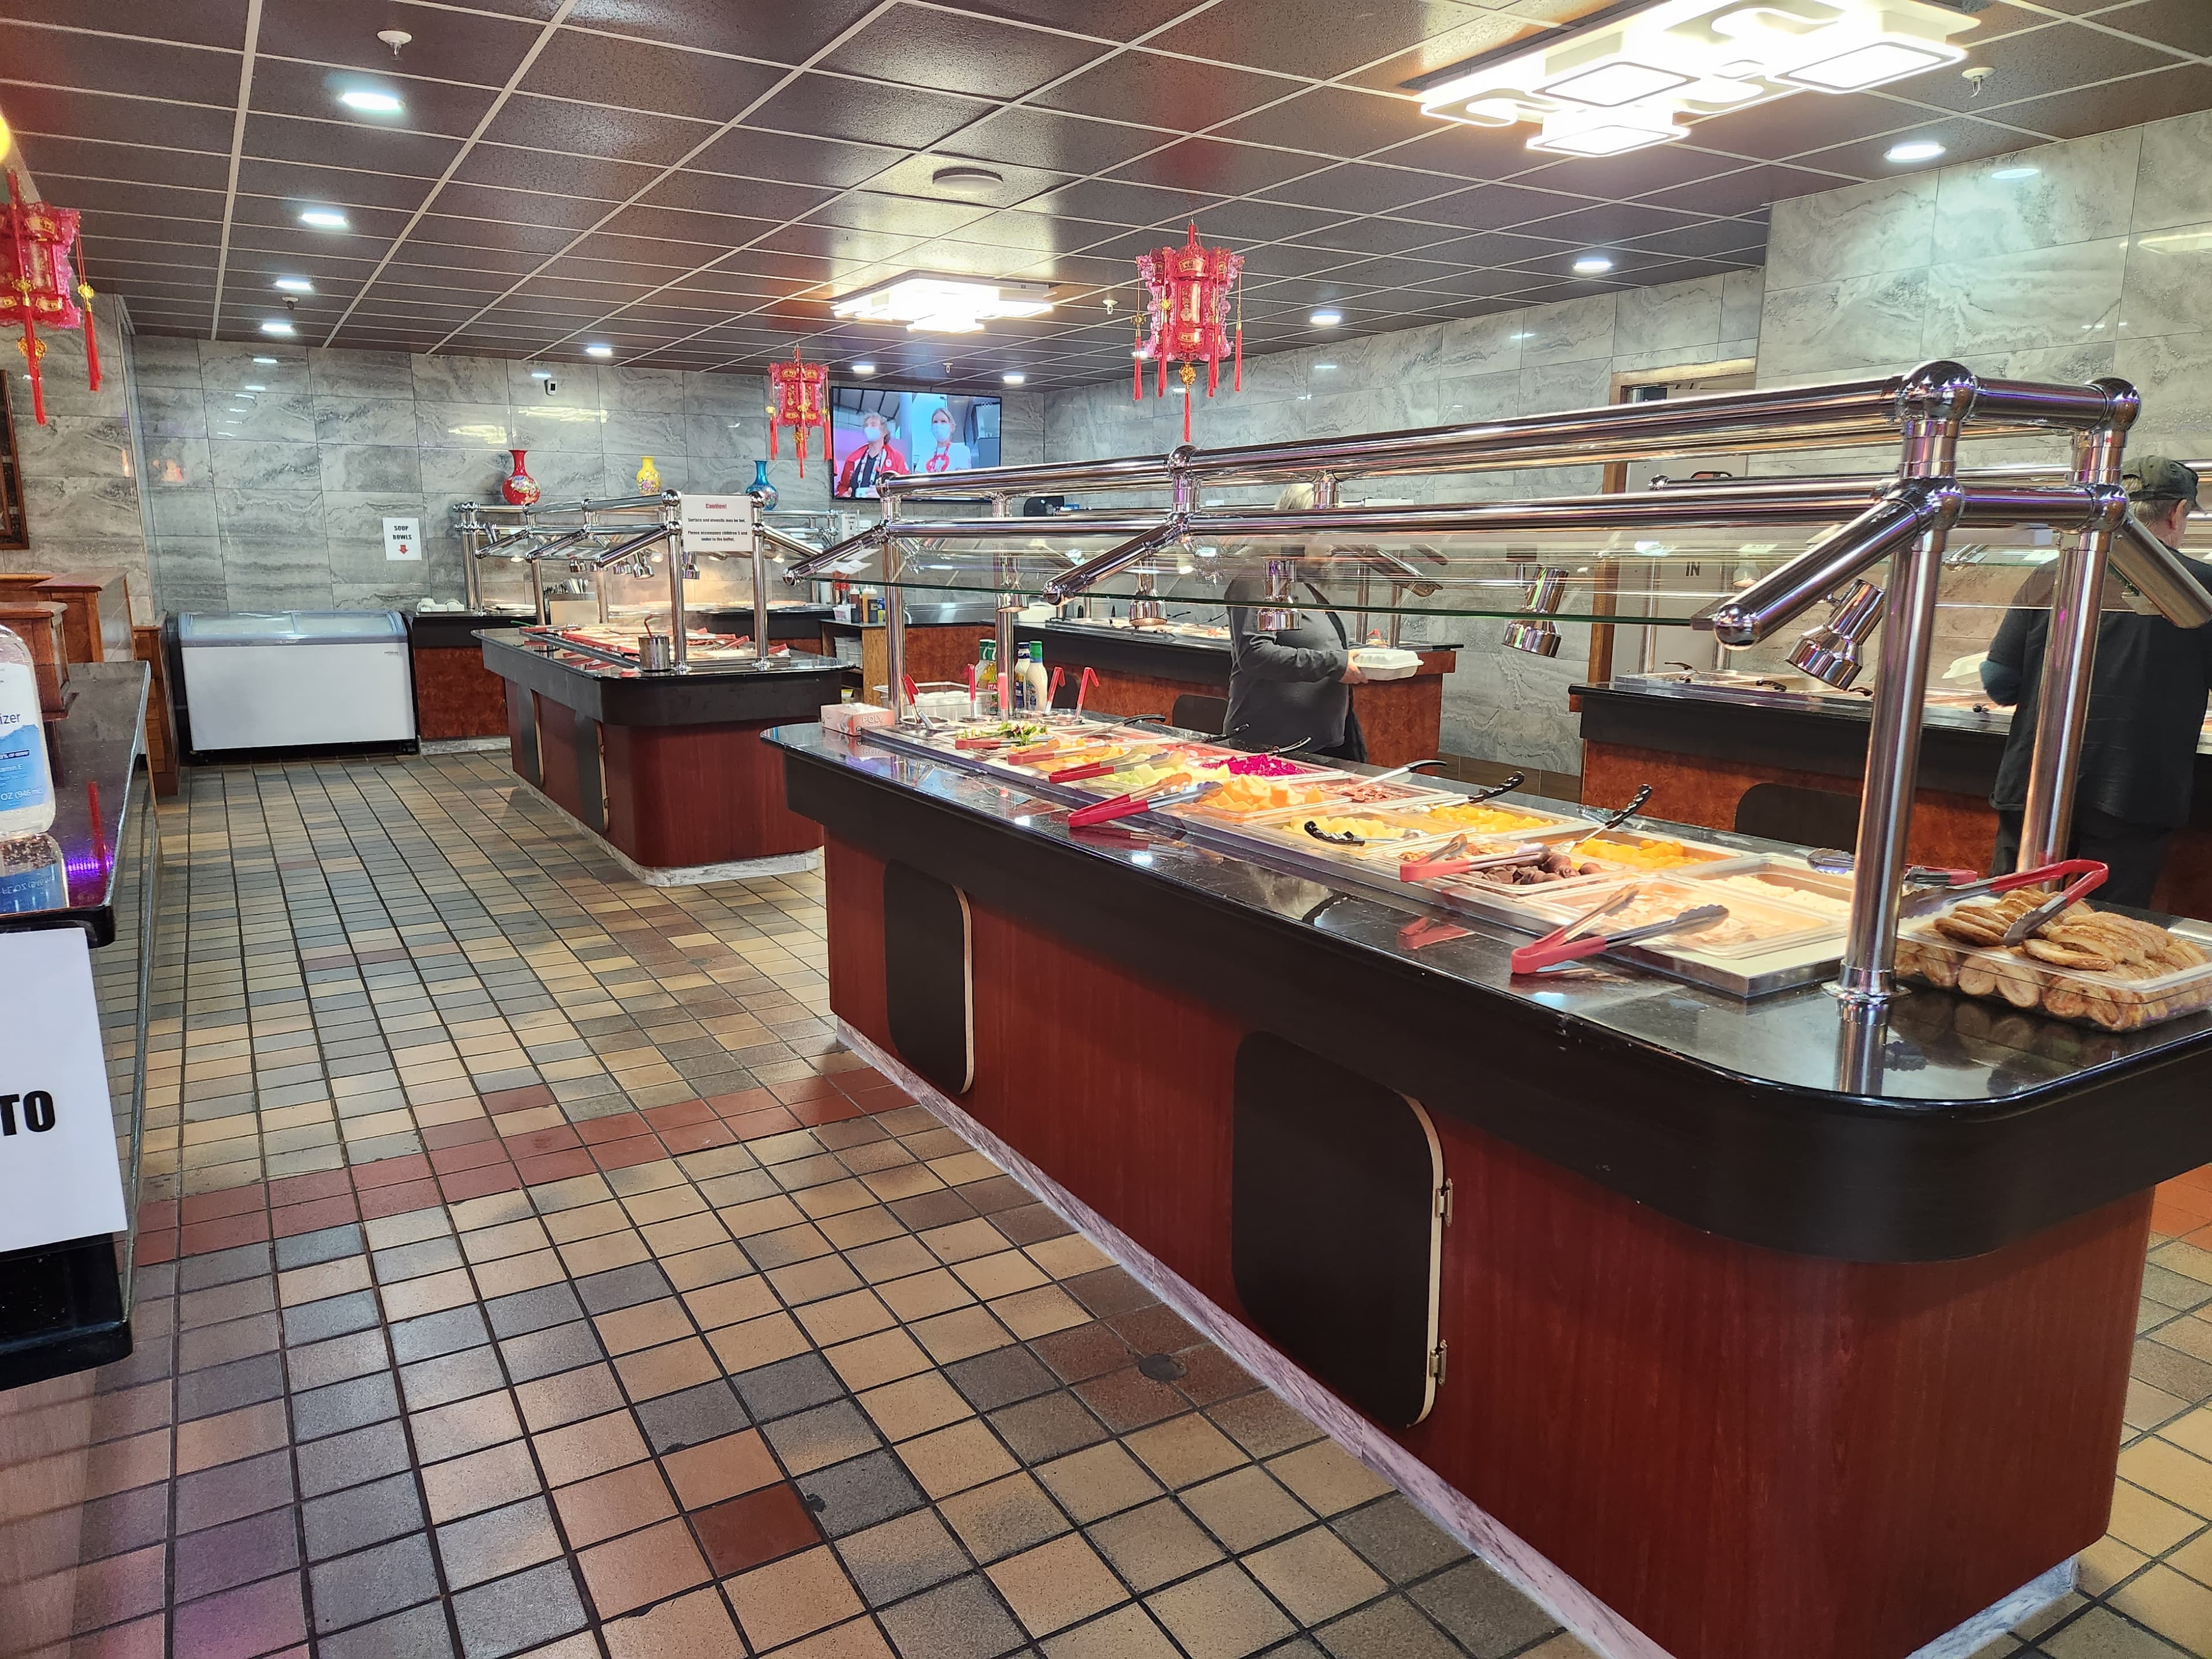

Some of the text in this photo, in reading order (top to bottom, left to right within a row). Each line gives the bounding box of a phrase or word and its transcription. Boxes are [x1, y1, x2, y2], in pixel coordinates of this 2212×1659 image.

[1685, 562, 1700, 577] IN
[862, 715, 882, 724] POLY
[1, 792, 14, 801] OZ
[0, 1090, 56, 1136] TO
